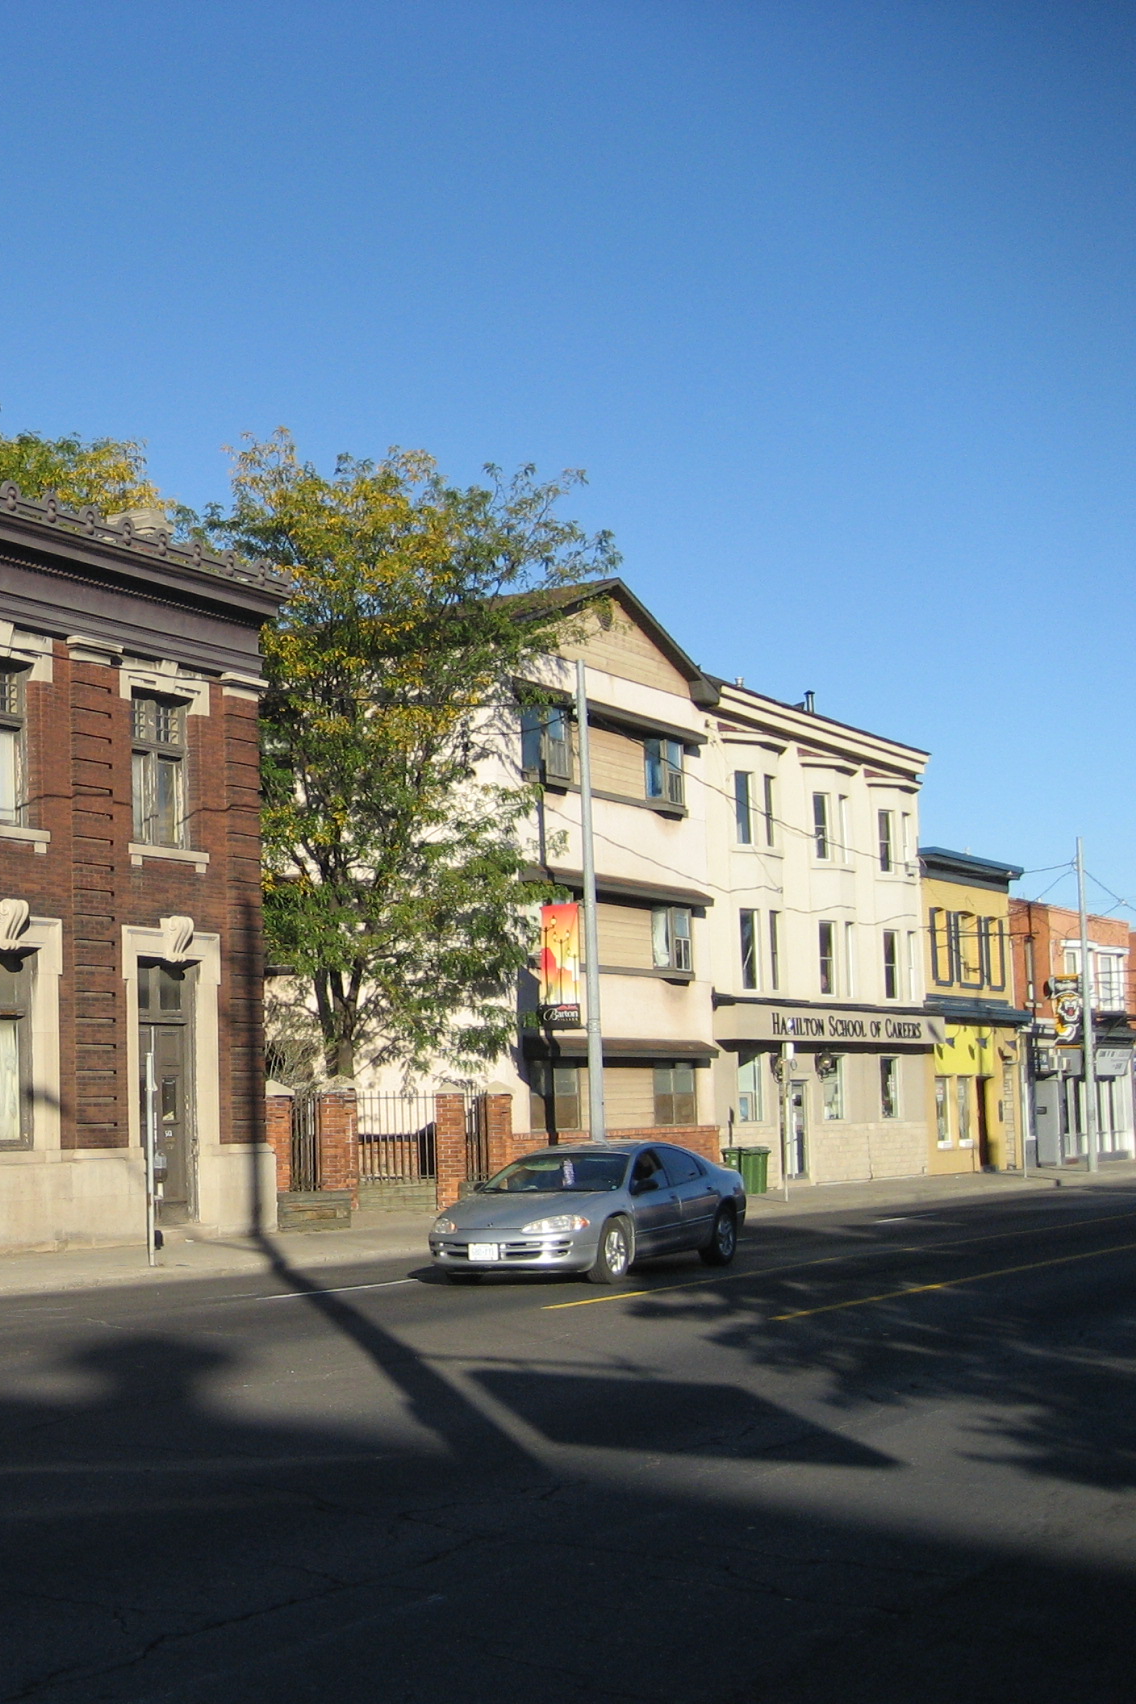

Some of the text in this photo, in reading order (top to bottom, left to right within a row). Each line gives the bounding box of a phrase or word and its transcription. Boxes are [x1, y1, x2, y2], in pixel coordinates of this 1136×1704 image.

[543, 1008, 578, 1020] Barton
[828, 1015, 867, 1037] SCHOOL
[870, 1020, 881, 1038] OF
[885, 1018, 922, 1039] CAREERS
